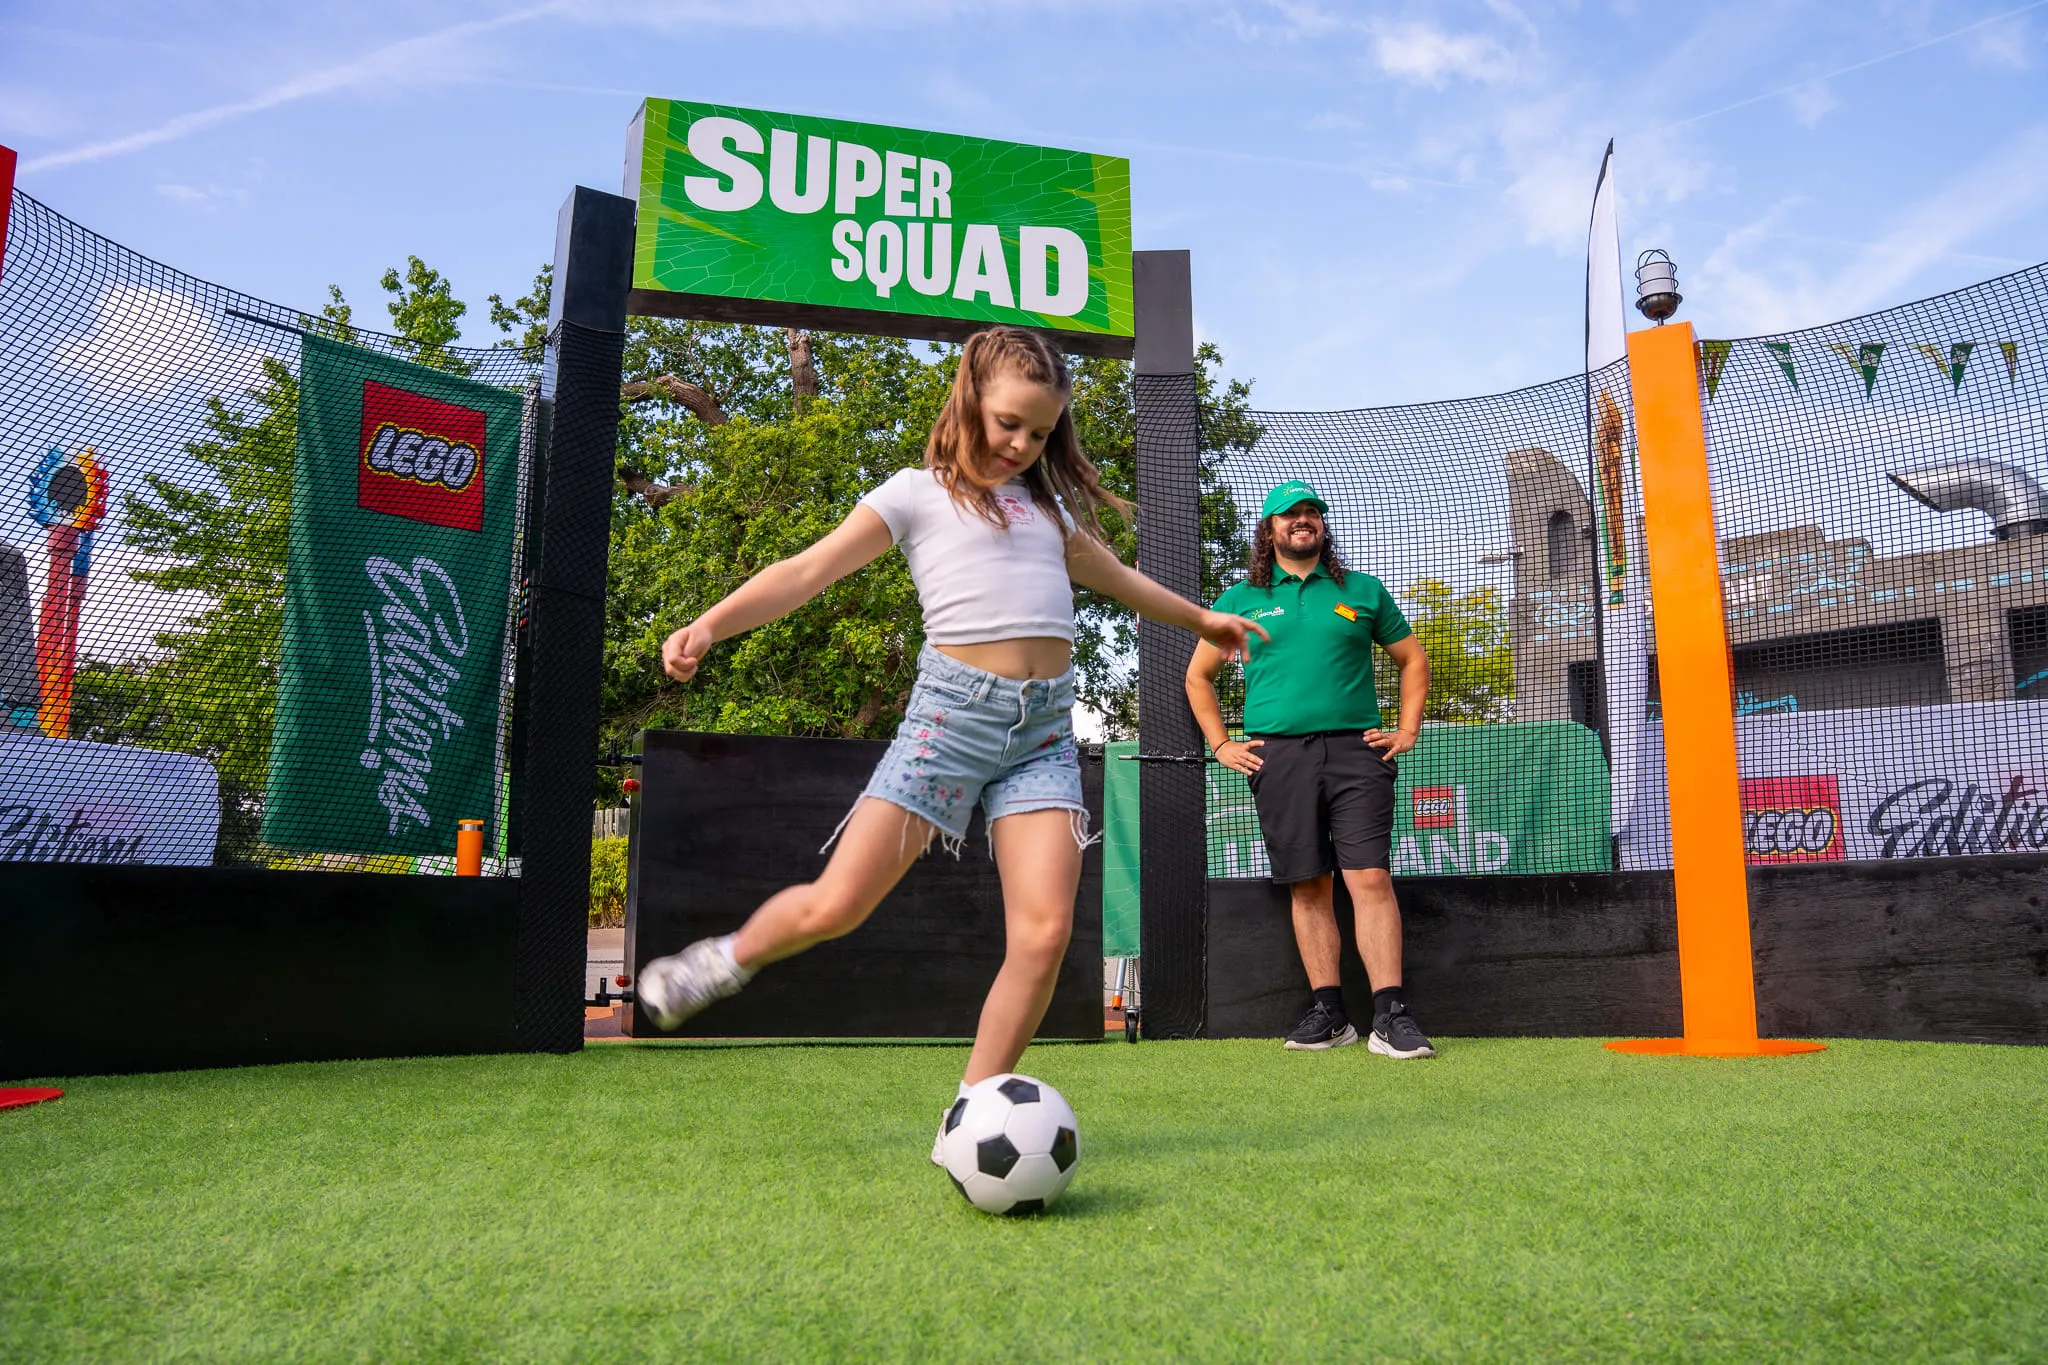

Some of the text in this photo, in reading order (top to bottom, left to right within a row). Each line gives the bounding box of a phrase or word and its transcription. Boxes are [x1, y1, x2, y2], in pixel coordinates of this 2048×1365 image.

[684, 116, 953, 219] SUPER
[831, 218, 1089, 317] SQUAD
[368, 424, 477, 489] LEGO
[1415, 797, 1451, 816] LEGO
